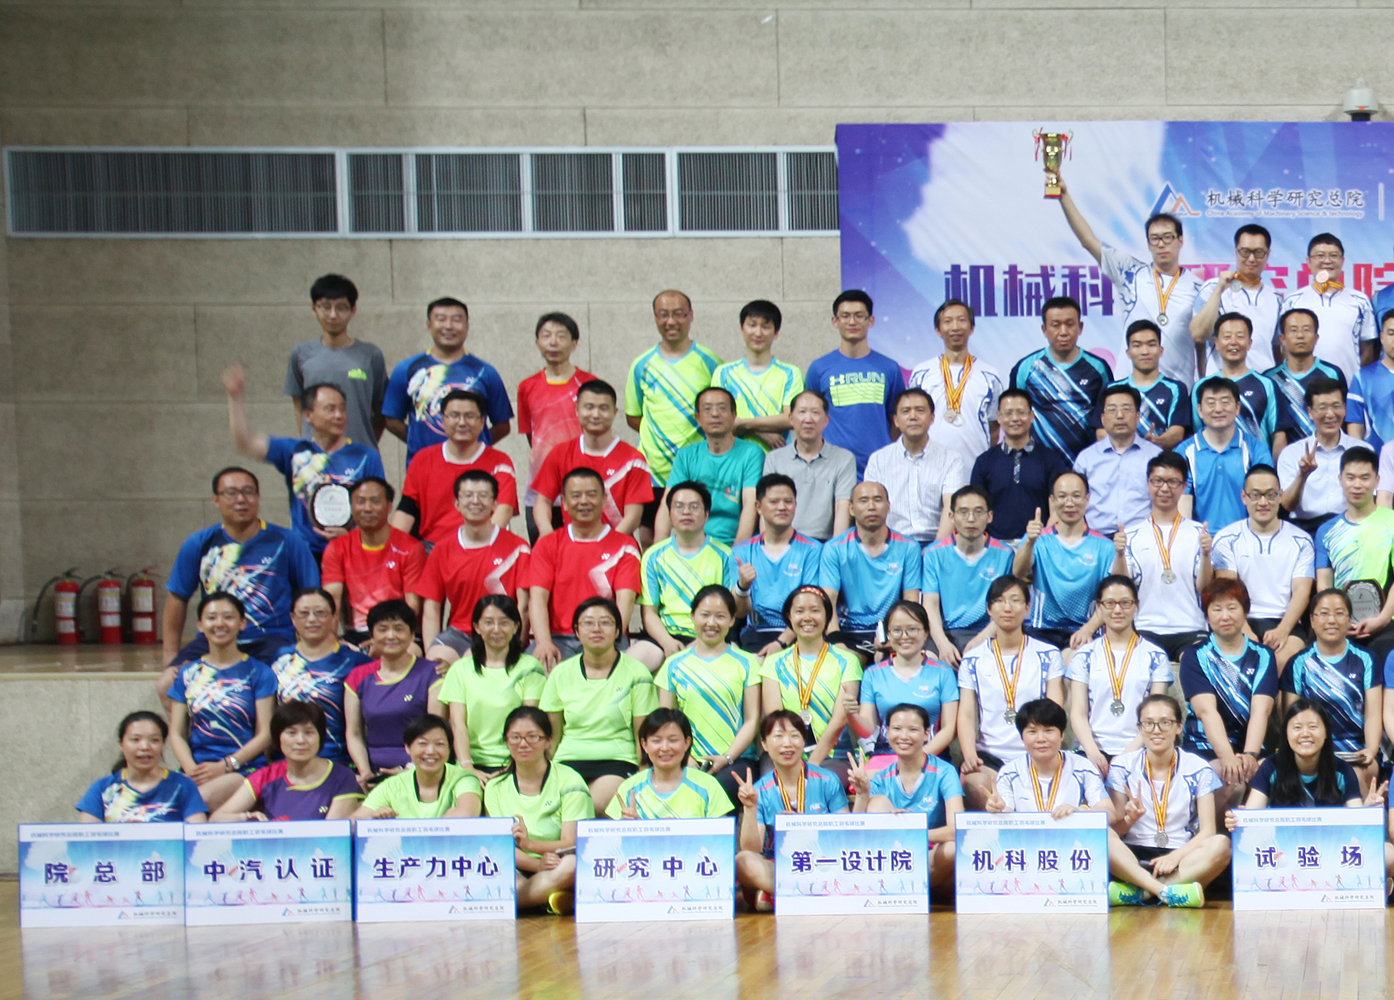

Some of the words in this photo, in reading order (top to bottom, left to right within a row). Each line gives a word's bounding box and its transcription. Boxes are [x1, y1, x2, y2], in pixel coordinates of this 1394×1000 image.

[1206, 189, 1364, 208] 机械科学研究总院
[1225, 210, 1254, 219] Academy
[1264, 210, 1296, 219] Machinery
[373, 856, 499, 878] 生产力中心
[593, 856, 718, 878] 研究中心
[791, 850, 912, 872] 第一设计院
[972, 849, 1092, 871] 机科股份
[1255, 846, 1362, 867] 试验场
[44, 861, 165, 884] 院总部
[203, 858, 334, 882] 中汽认证
